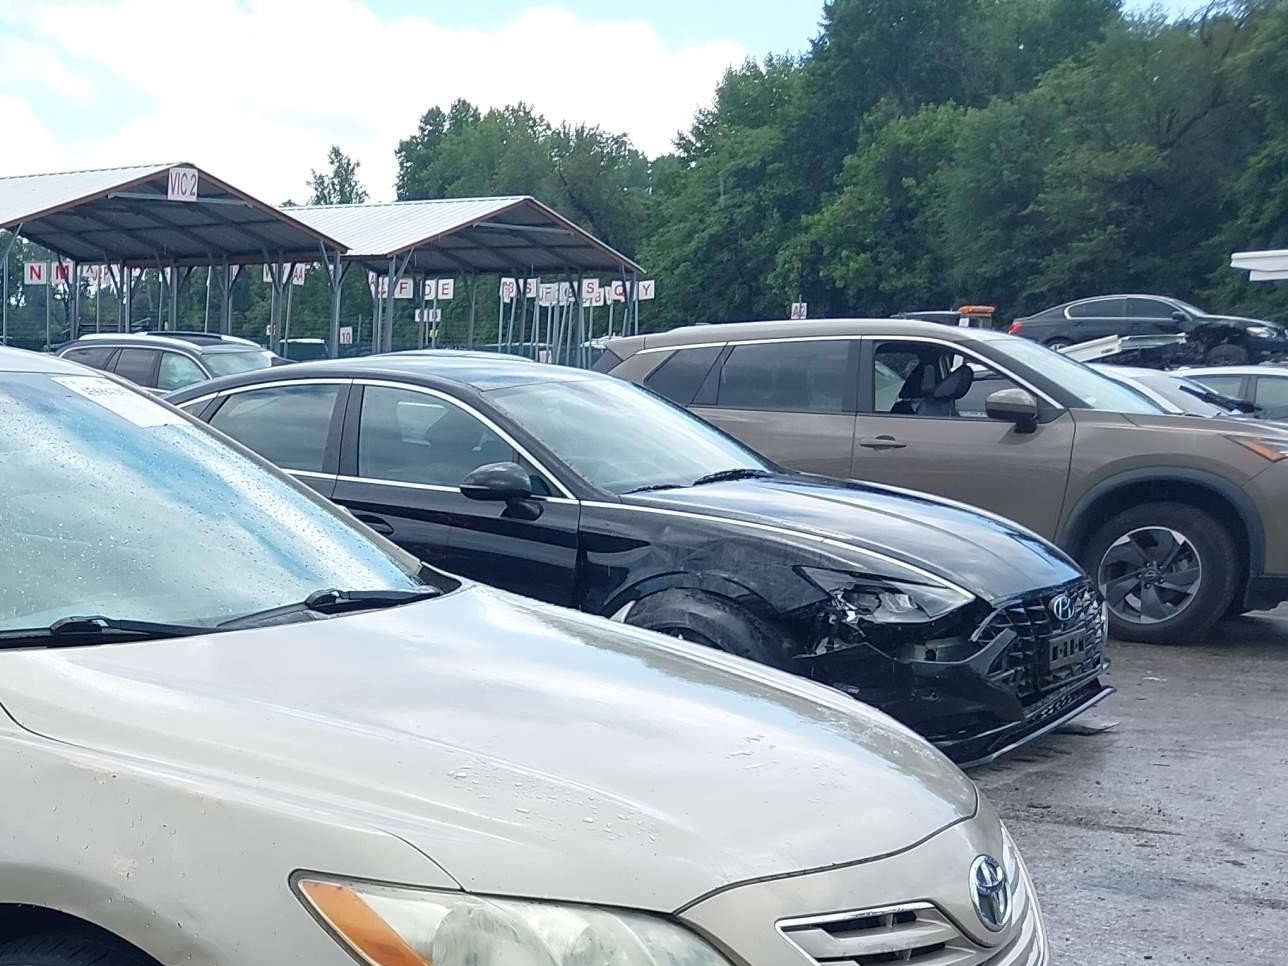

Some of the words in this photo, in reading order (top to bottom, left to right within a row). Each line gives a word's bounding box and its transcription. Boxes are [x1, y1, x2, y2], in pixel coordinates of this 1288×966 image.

[170, 172, 188, 196] VIC
[190, 173, 197, 196] 2
[30, 265, 42, 281] N
[399, 282, 409, 295] F
[442, 282, 450, 296] E
[586, 282, 594, 294] S
[642, 284, 651, 296] Y
